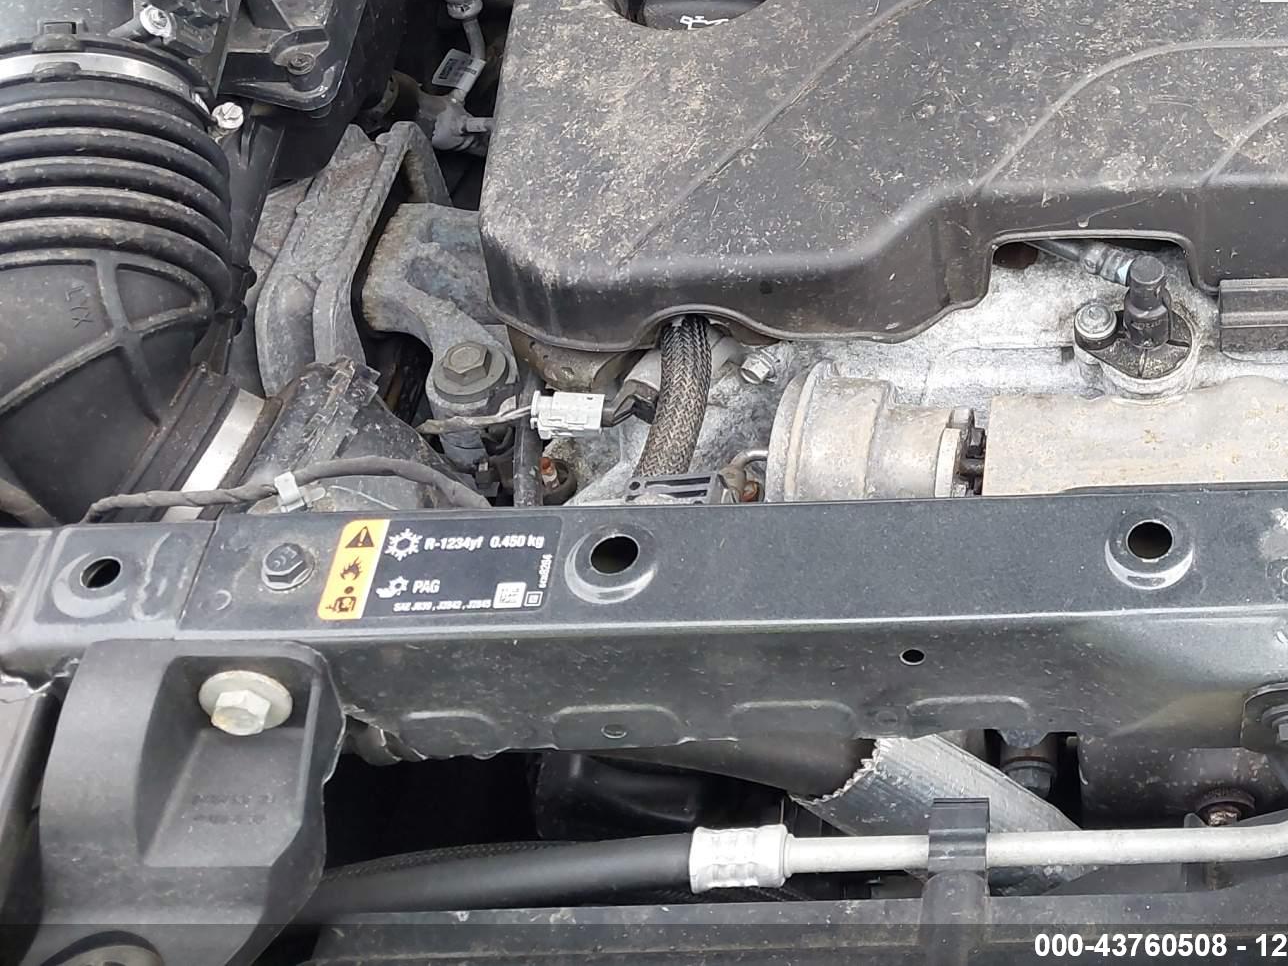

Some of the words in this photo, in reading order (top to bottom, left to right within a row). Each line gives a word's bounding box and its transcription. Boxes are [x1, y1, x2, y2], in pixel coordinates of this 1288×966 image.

[424, 535, 483, 551] R-1234yf
[527, 535, 544, 549] kg
[412, 579, 440, 594] PAG
